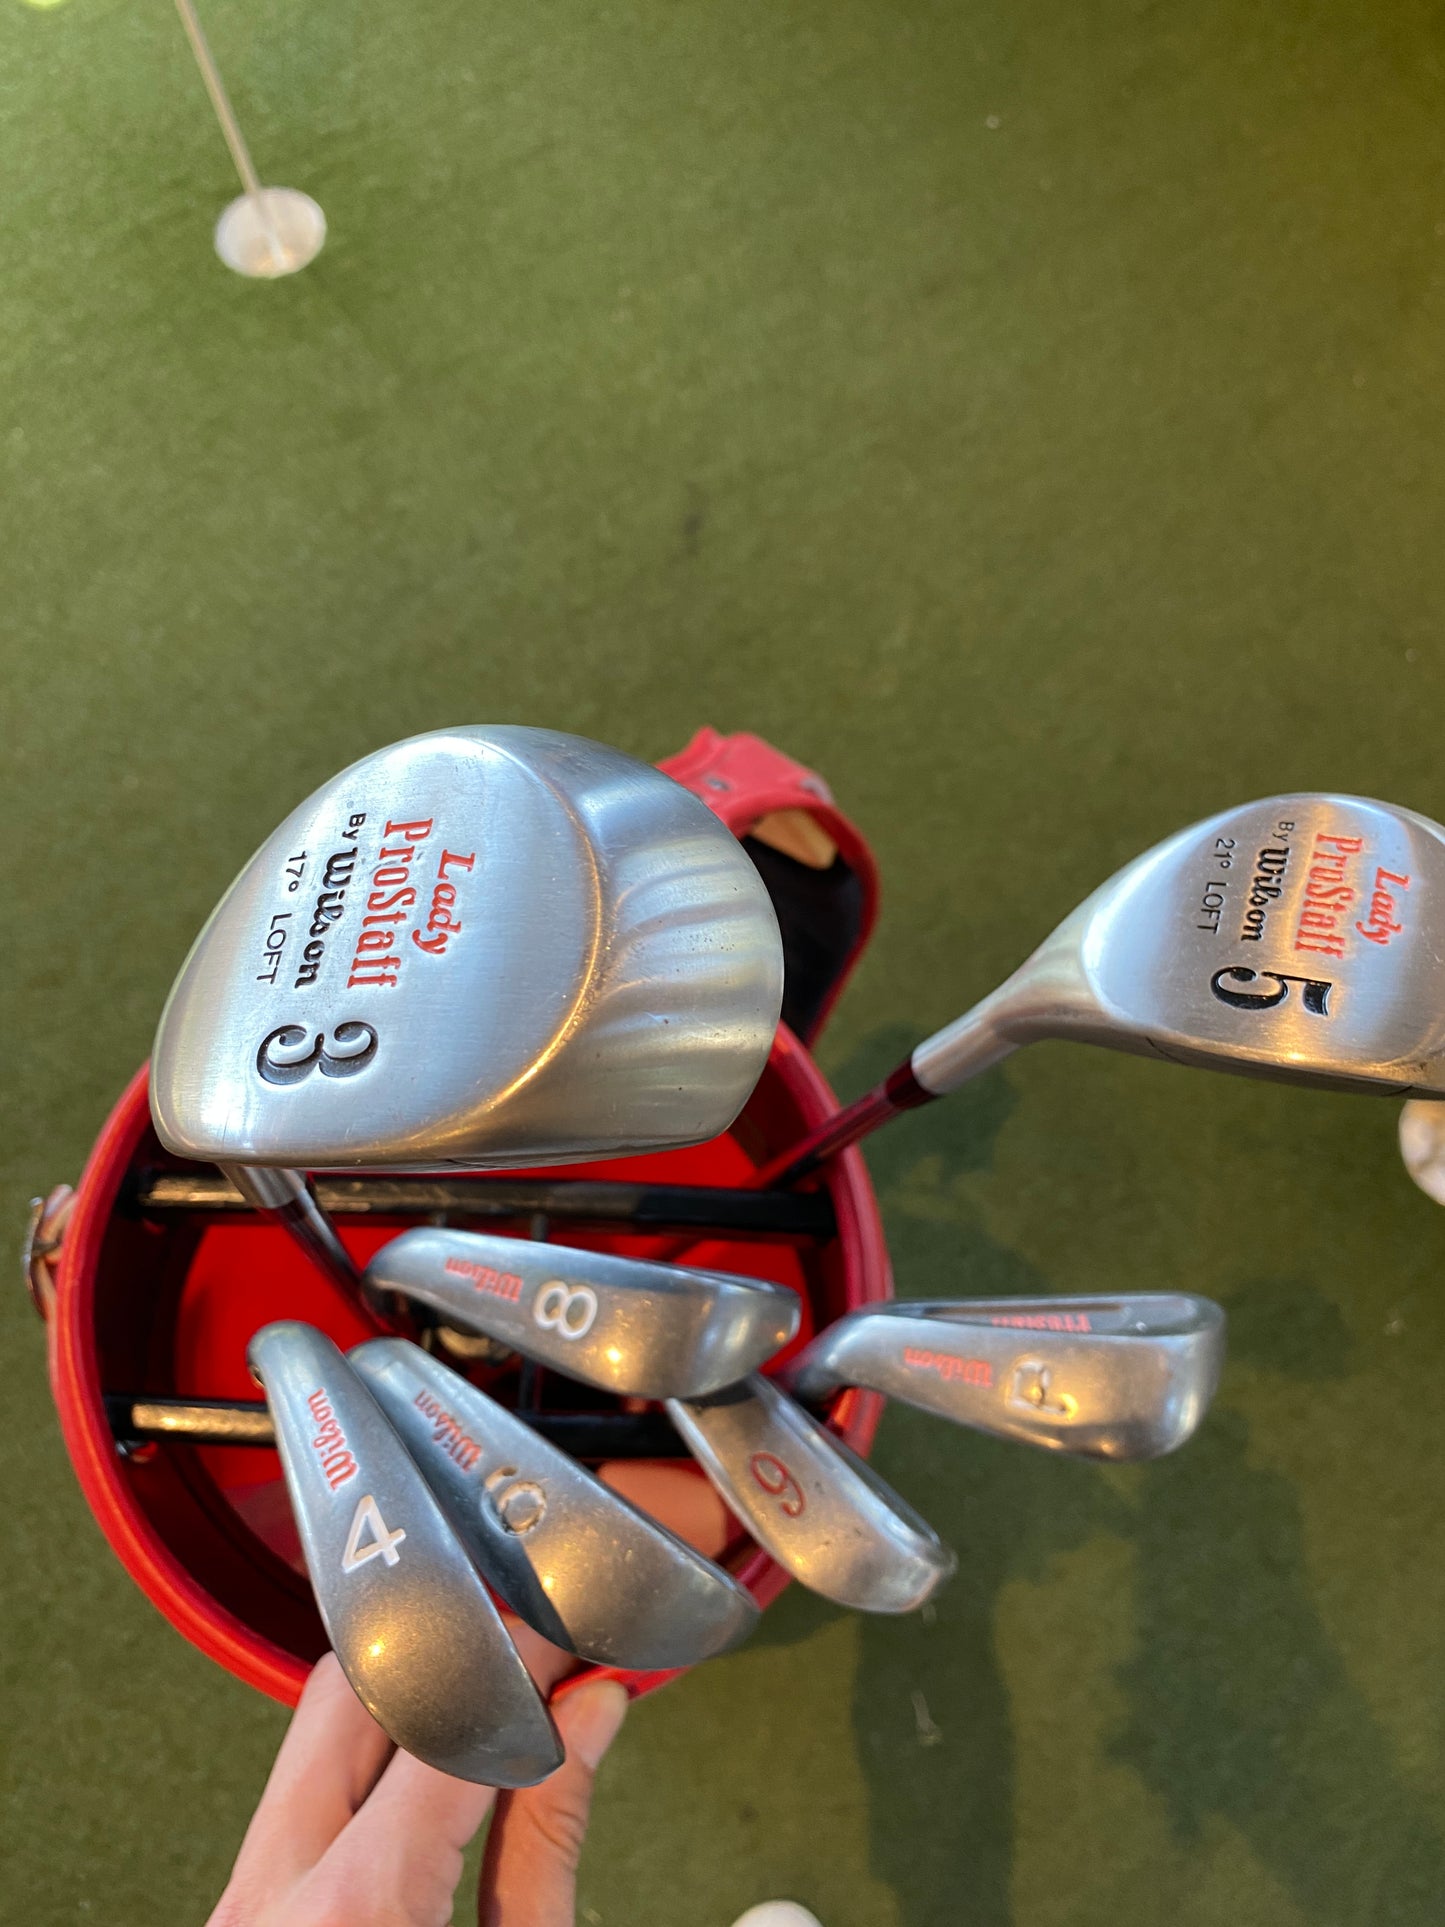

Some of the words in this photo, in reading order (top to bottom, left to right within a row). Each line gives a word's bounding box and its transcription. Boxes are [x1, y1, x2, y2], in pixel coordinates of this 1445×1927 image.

[342, 812, 366, 840] By
[1272, 821, 1295, 841] By
[294, 847, 358, 988] Wilson
[412, 849, 475, 954] Lady
[1197, 881, 1227, 934] LOFT
[1241, 847, 1289, 941] Wilson
[1356, 866, 1411, 945] Lady
[256, 913, 292, 984] LOFT
[1210, 966, 1333, 1016] 5
[256, 1021, 379, 1085] 3
[444, 1257, 523, 1303] Wilson
[533, 1279, 598, 1340] 8
[904, 1346, 993, 1388] Wilson
[307, 1387, 359, 1491] Wilson
[413, 1388, 482, 1473] Wilson
[341, 1494, 406, 1574] 4
[481, 1466, 547, 1537] 6
